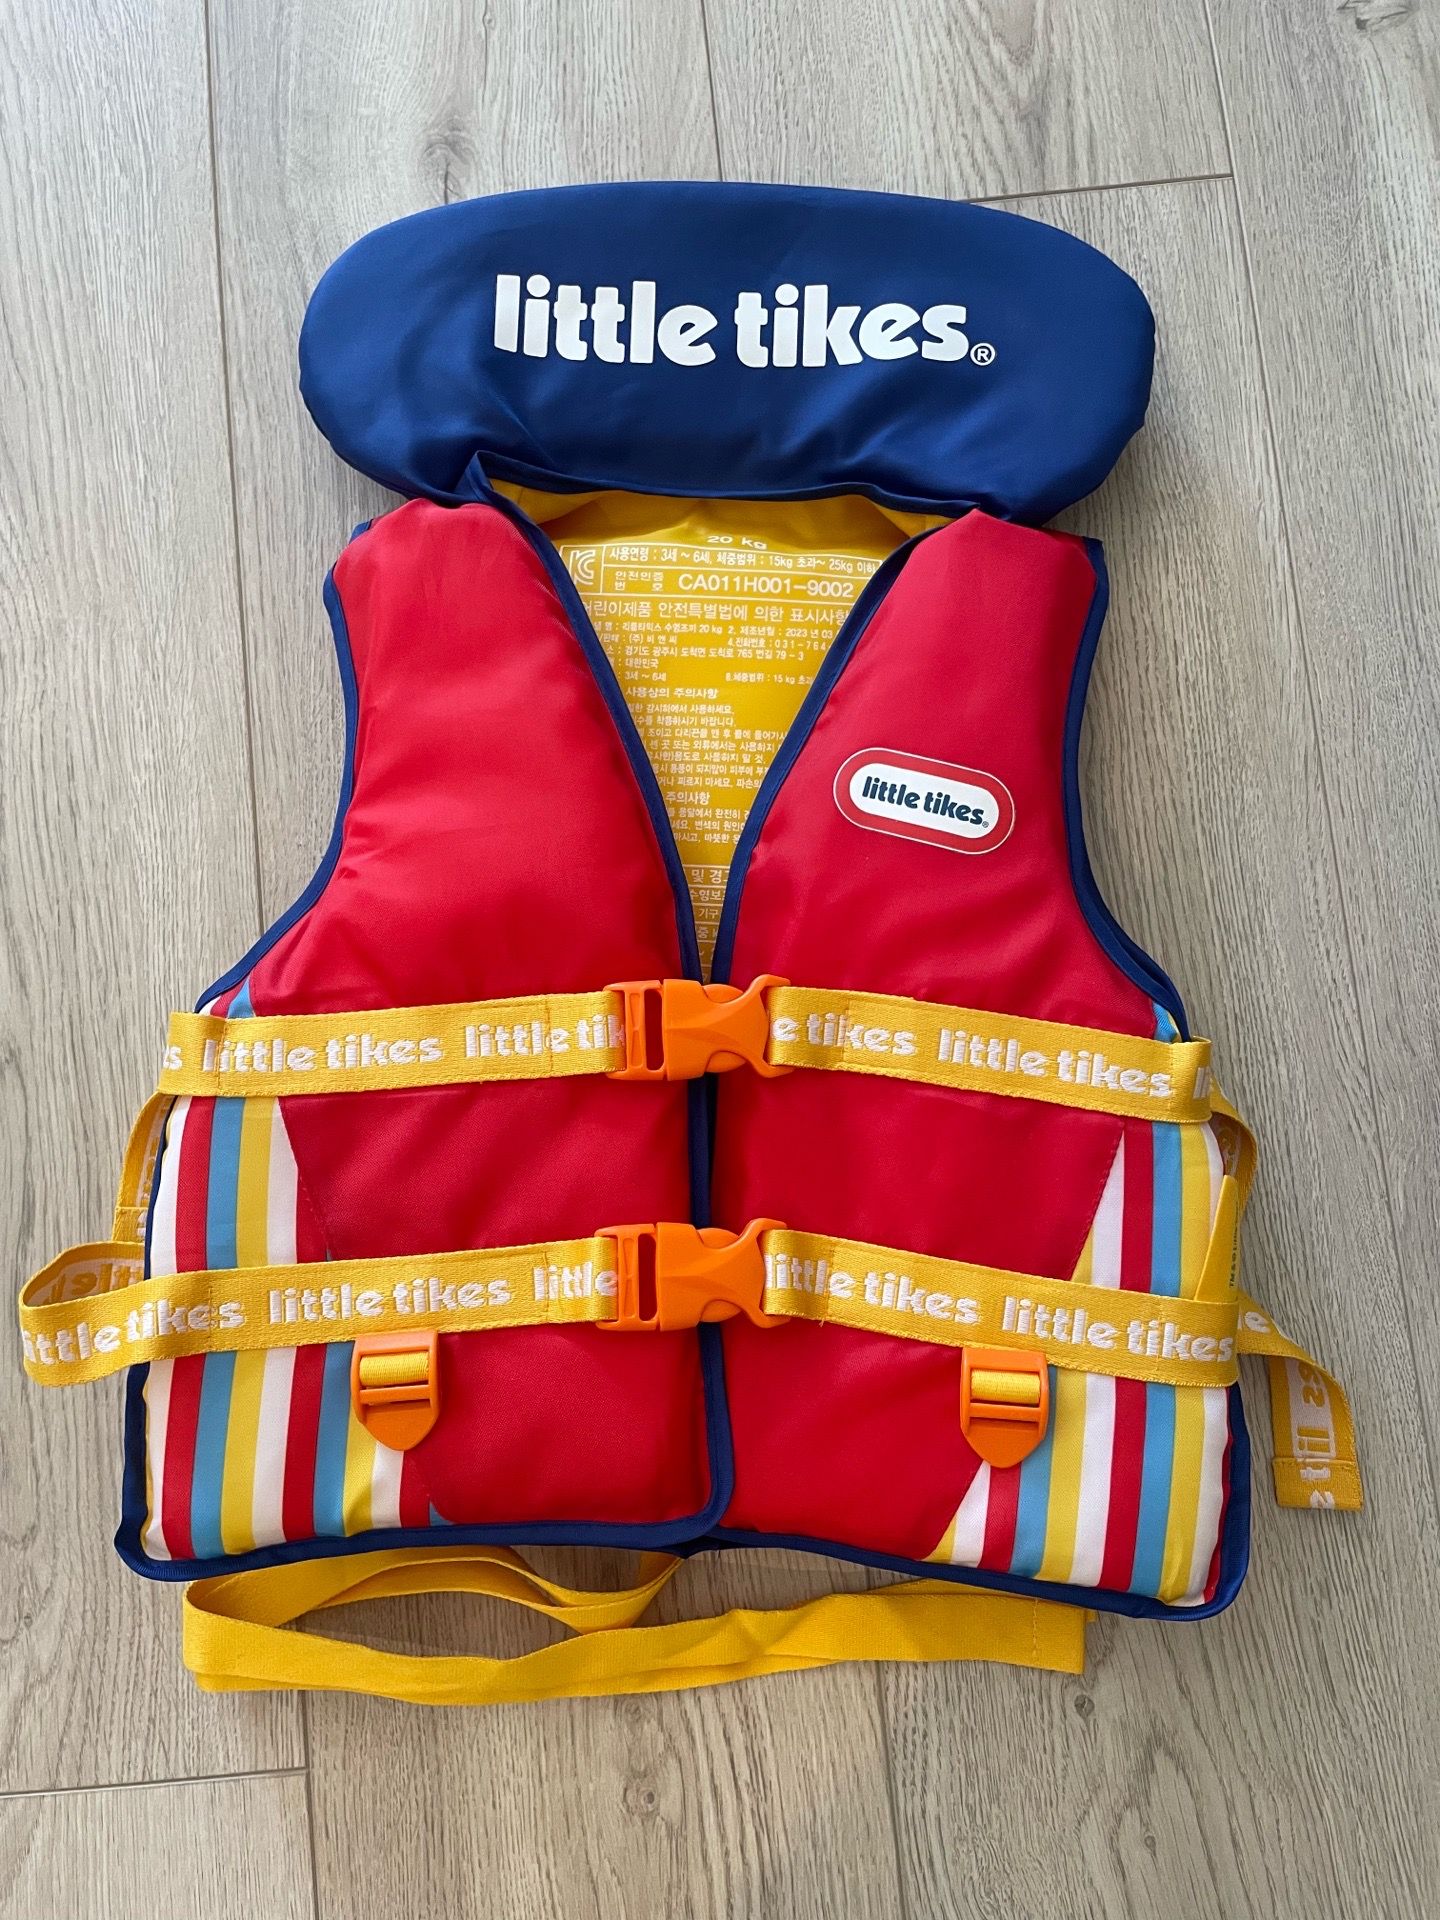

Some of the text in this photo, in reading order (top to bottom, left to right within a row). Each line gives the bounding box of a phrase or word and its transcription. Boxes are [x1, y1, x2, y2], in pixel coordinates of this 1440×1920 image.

[494, 274, 718, 367] little
[707, 535, 767, 550] 20 kg
[658, 602, 748, 621] 안전특별법에
[754, 606, 784, 622] 의한
[678, 573, 854, 598] CA011H001-9002
[862, 776, 920, 809] little
[203, 1038, 317, 1073] little
[326, 1033, 443, 1069] tikes
[465, 1020, 570, 1058] little
[805, 1012, 917, 1055] tikes
[938, 1028, 1048, 1078] little
[1057, 1050, 1173, 1098] tikes
[126, 1298, 246, 1343] tikes
[269, 1283, 384, 1324] little
[393, 1277, 512, 1314] tikes
[533, 1261, 618, 1301] little
[764, 1253, 855, 1299] little
[864, 1272, 982, 1325] tikes
[1002, 1296, 1121, 1349] little
